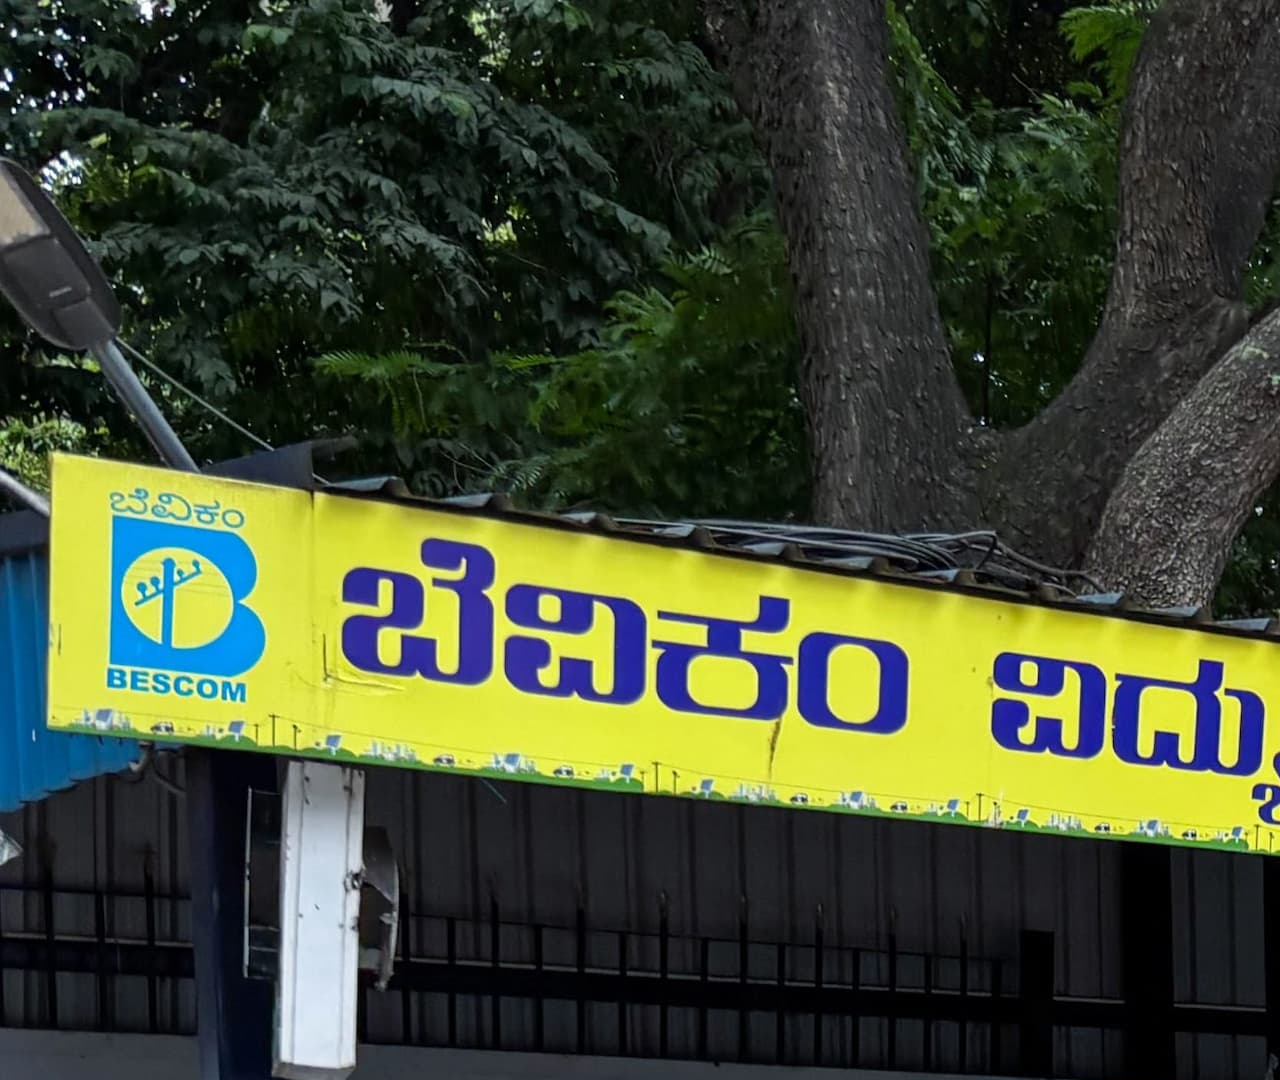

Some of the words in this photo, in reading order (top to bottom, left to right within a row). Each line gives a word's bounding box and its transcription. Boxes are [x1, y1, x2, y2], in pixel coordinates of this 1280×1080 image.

[109, 488, 245, 529] ಬೆವಿಕಂ
[342, 537, 909, 734] ಬೆವಿಕಂ
[106, 667, 247, 703] BESCOM
